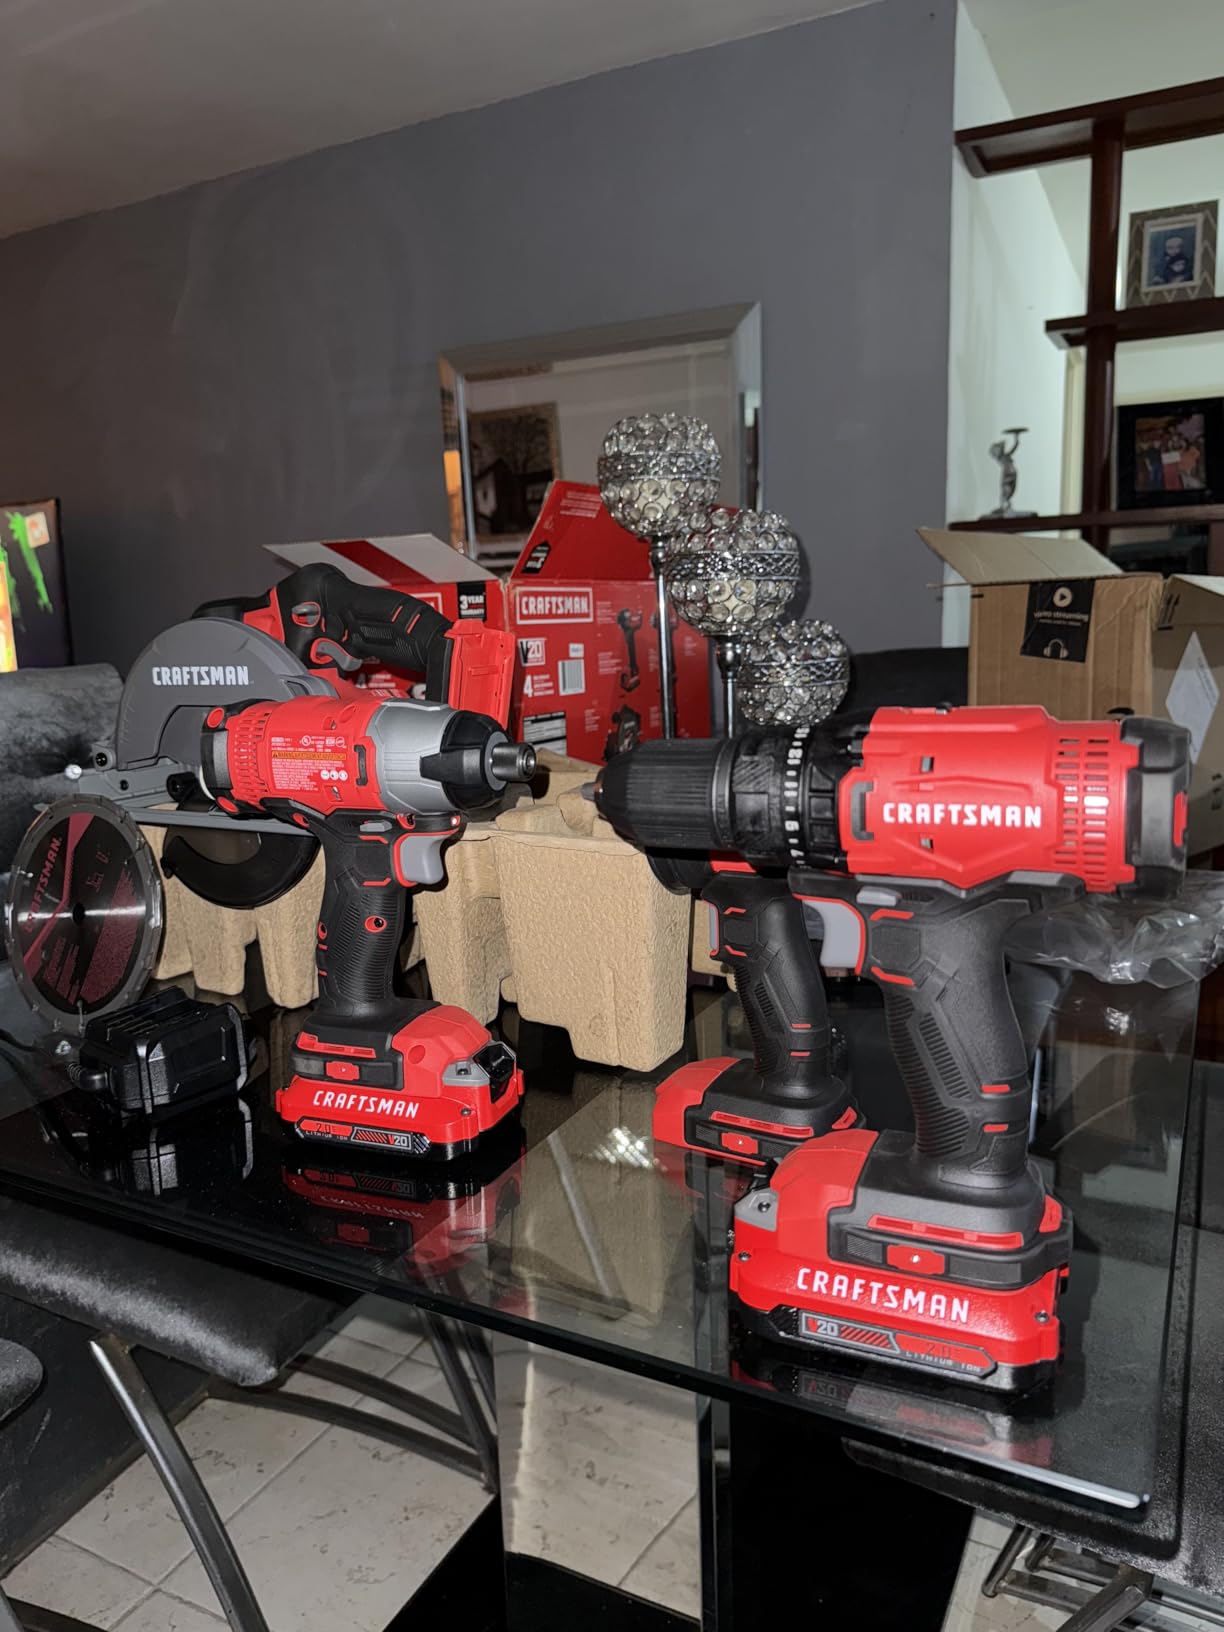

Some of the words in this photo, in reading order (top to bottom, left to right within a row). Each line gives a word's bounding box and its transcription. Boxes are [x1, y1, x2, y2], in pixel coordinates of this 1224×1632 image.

[460, 594, 469, 609] 3
[521, 596, 588, 615] CRAFTSMAN
[519, 640, 543, 664] V20
[152, 666, 249, 686] CRAFTSMAN
[523, 674, 534, 698] 4
[883, 802, 1041, 828] CRAFTSMAN
[24, 836, 61, 934] CAFTSMAN
[313, 1090, 420, 1119] CRAFTSMAN
[387, 1134, 408, 1147] V20
[796, 1267, 970, 1323] CRAFTSMAN
[807, 1317, 838, 1337] V20
